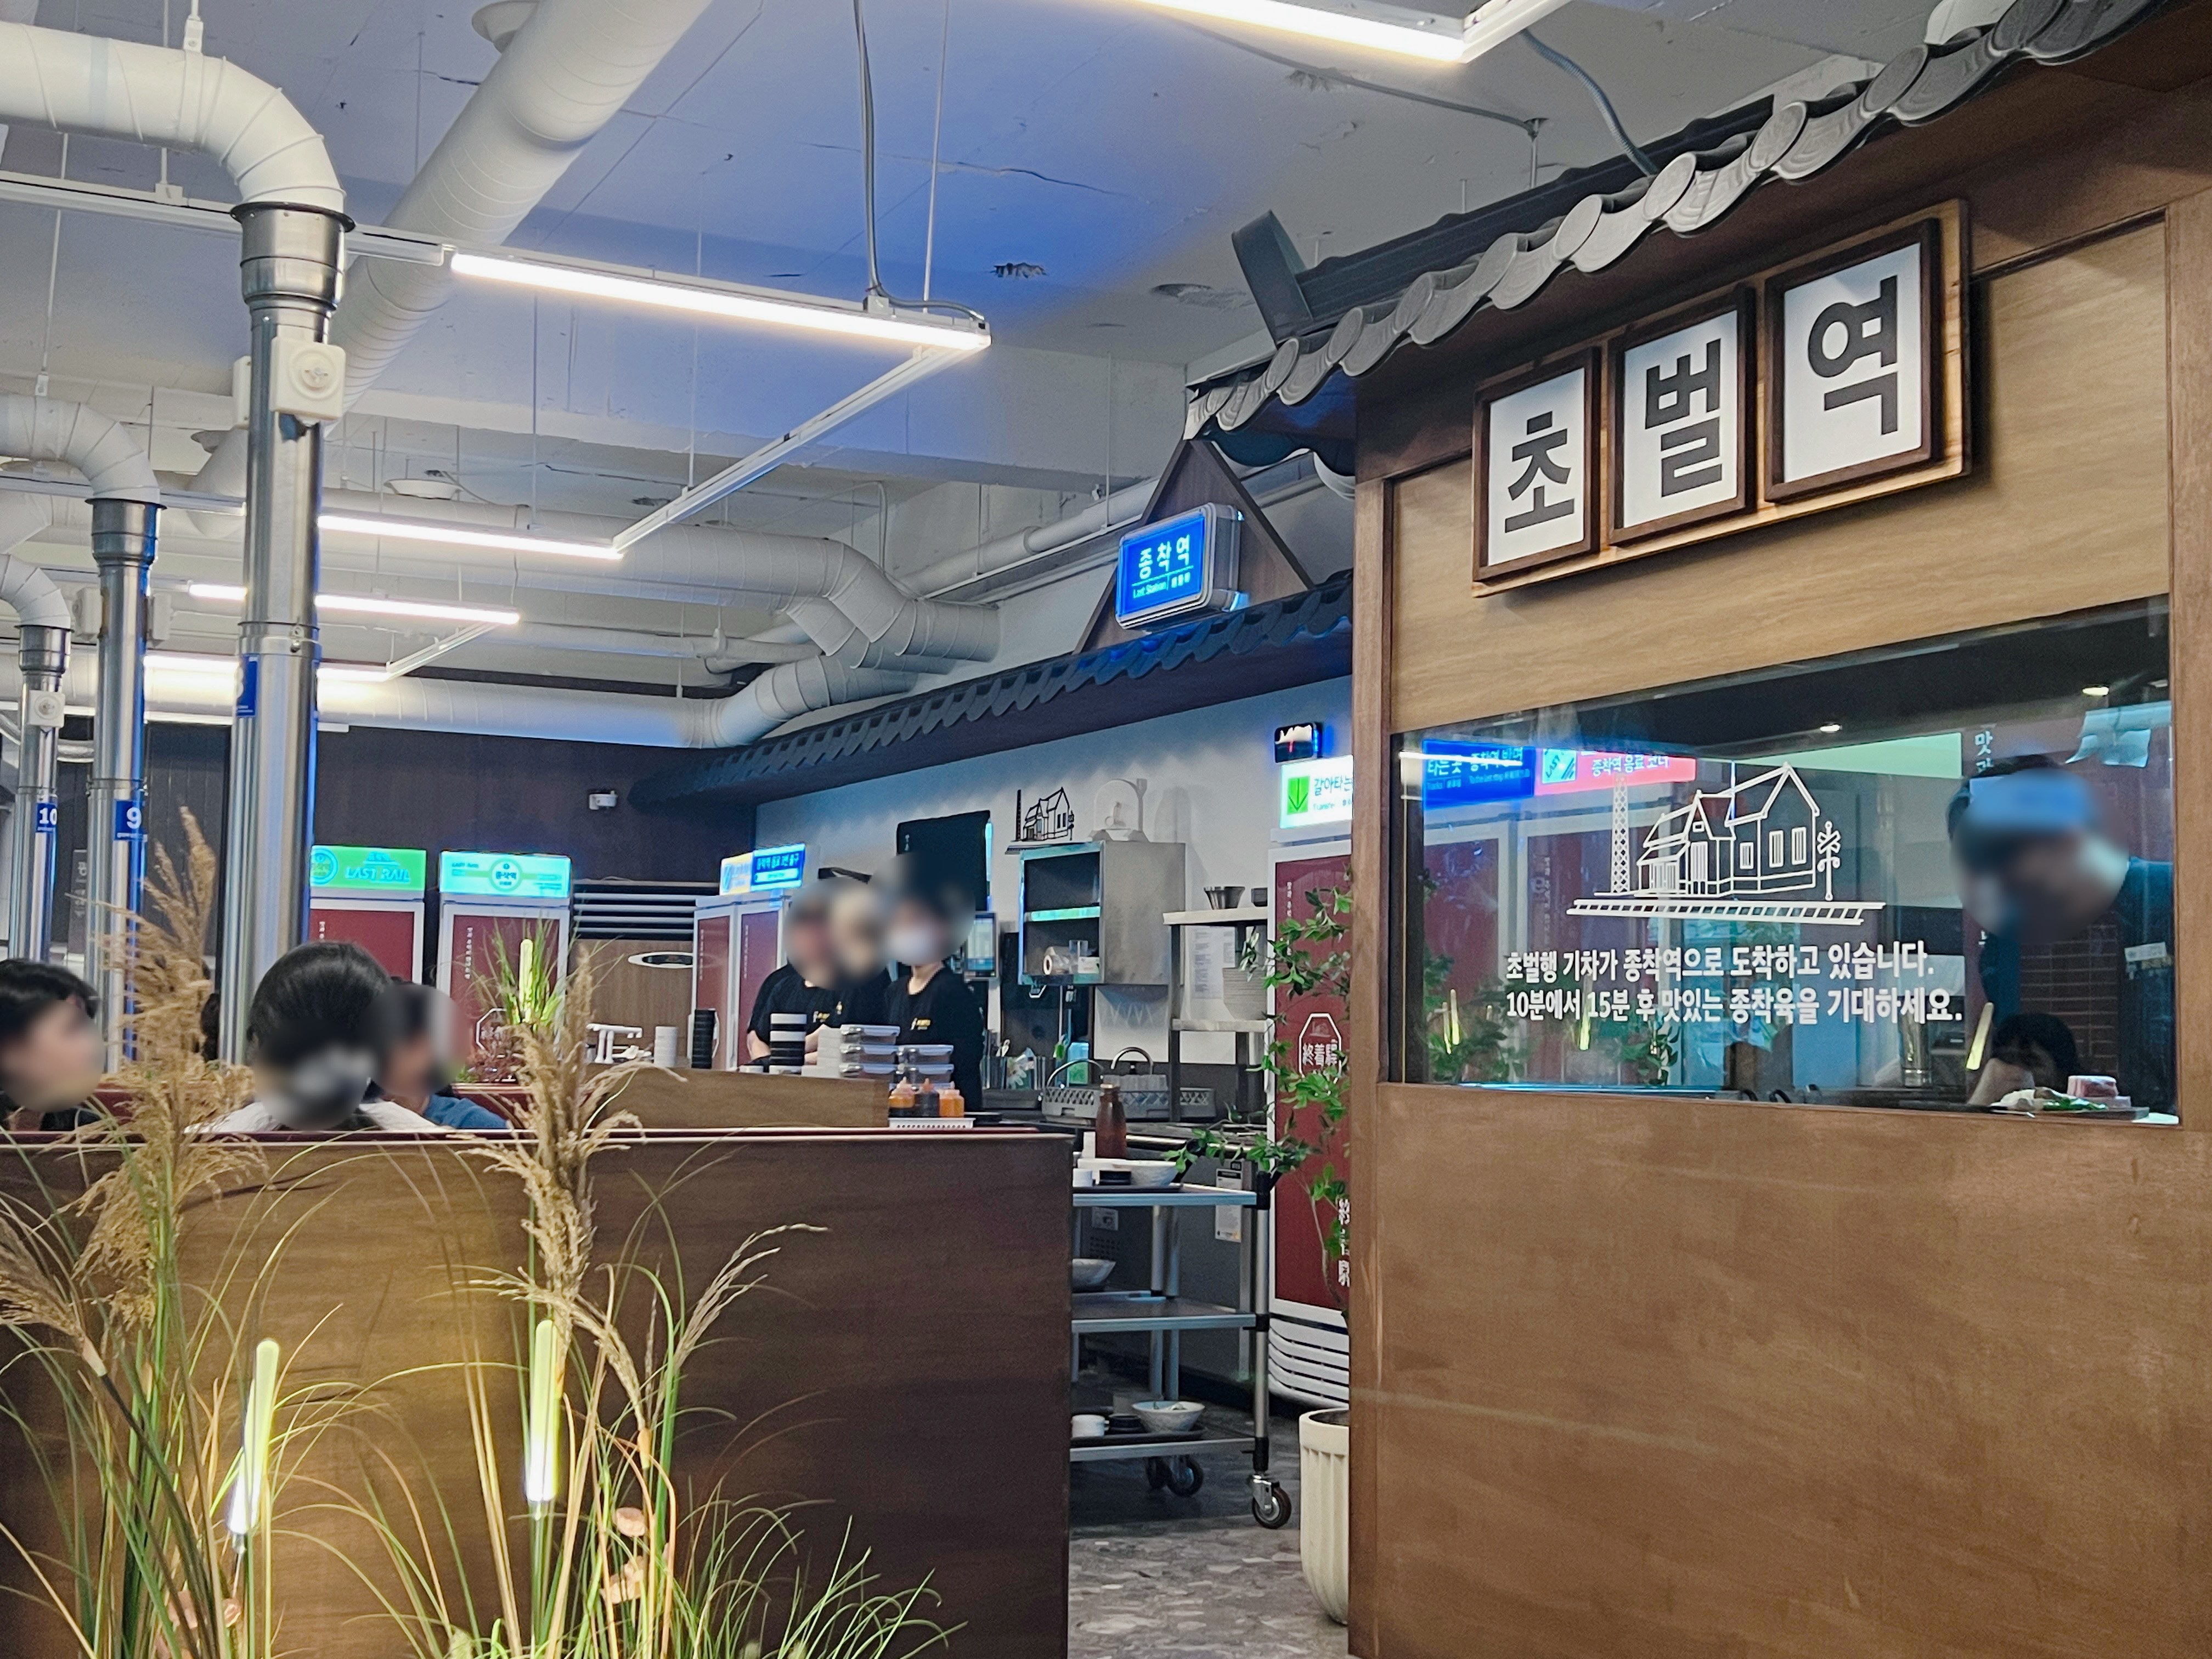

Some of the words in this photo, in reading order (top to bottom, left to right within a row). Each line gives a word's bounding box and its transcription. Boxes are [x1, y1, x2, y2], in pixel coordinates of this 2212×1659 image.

[1504, 275, 1899, 533] 초벌역
[1138, 534, 1190, 579] 종착역
[1592, 755, 1621, 777] 종착역
[39, 808, 58, 826] 10
[126, 806, 142, 829] 9
[1505, 951, 1558, 984] 초벌행
[1562, 949, 1618, 981] 기차가
[1623, 947, 1724, 983] 종착역으로
[1730, 944, 1821, 981] 도착하고
[1827, 940, 1934, 980] 있습니다.
[1506, 989, 1582, 1021] 10분에서
[1587, 989, 1630, 1022] 15분
[1635, 989, 1656, 1022] 후
[1661, 988, 1724, 1023] 맛있는
[1729, 988, 1820, 1024] 종착육을
[1827, 986, 1962, 1024] 기대하세요.
